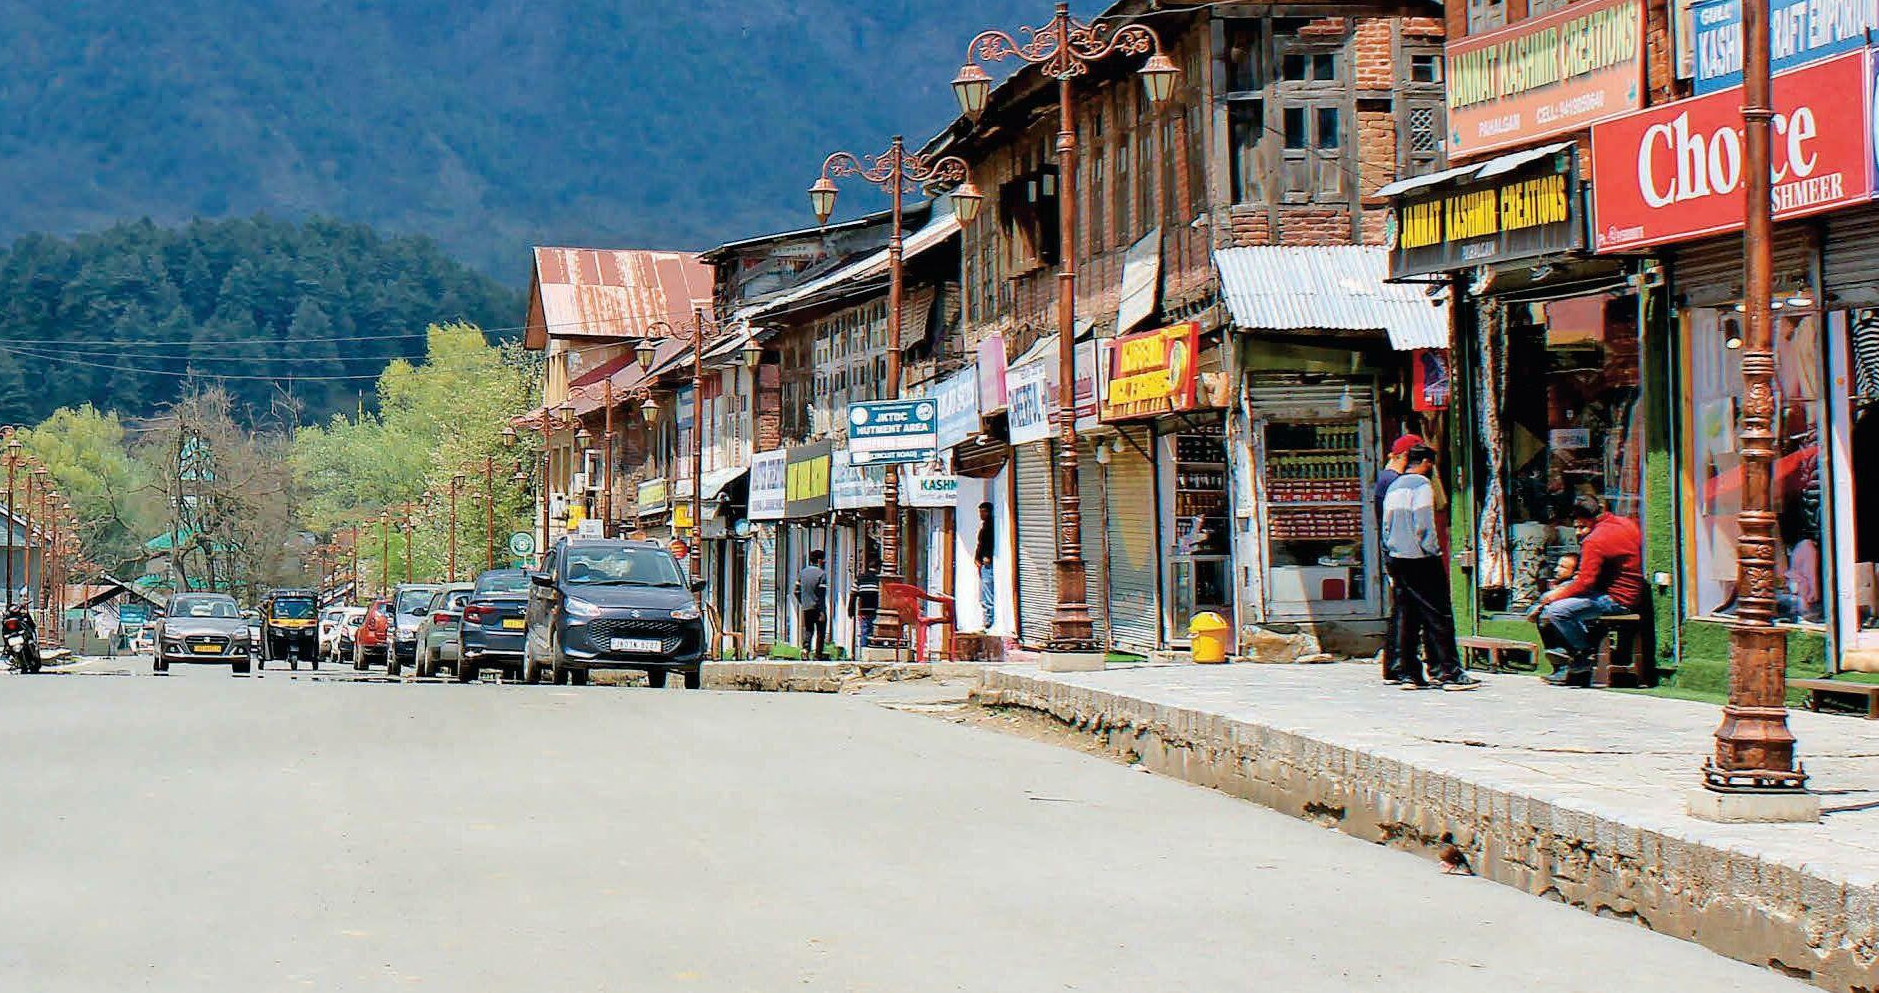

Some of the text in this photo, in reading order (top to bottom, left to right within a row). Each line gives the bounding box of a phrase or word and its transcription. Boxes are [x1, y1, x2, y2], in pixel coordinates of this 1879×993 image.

[1449, 0, 1638, 110] JANNAT KASHMIR CREATIONS
[1772, 1, 1808, 61] RAFT
[1401, 174, 1567, 250] JANNAT KASHMIR CREATIONS
[1772, 172, 1844, 212] SHMEER
[903, 423, 928, 432] AREA
